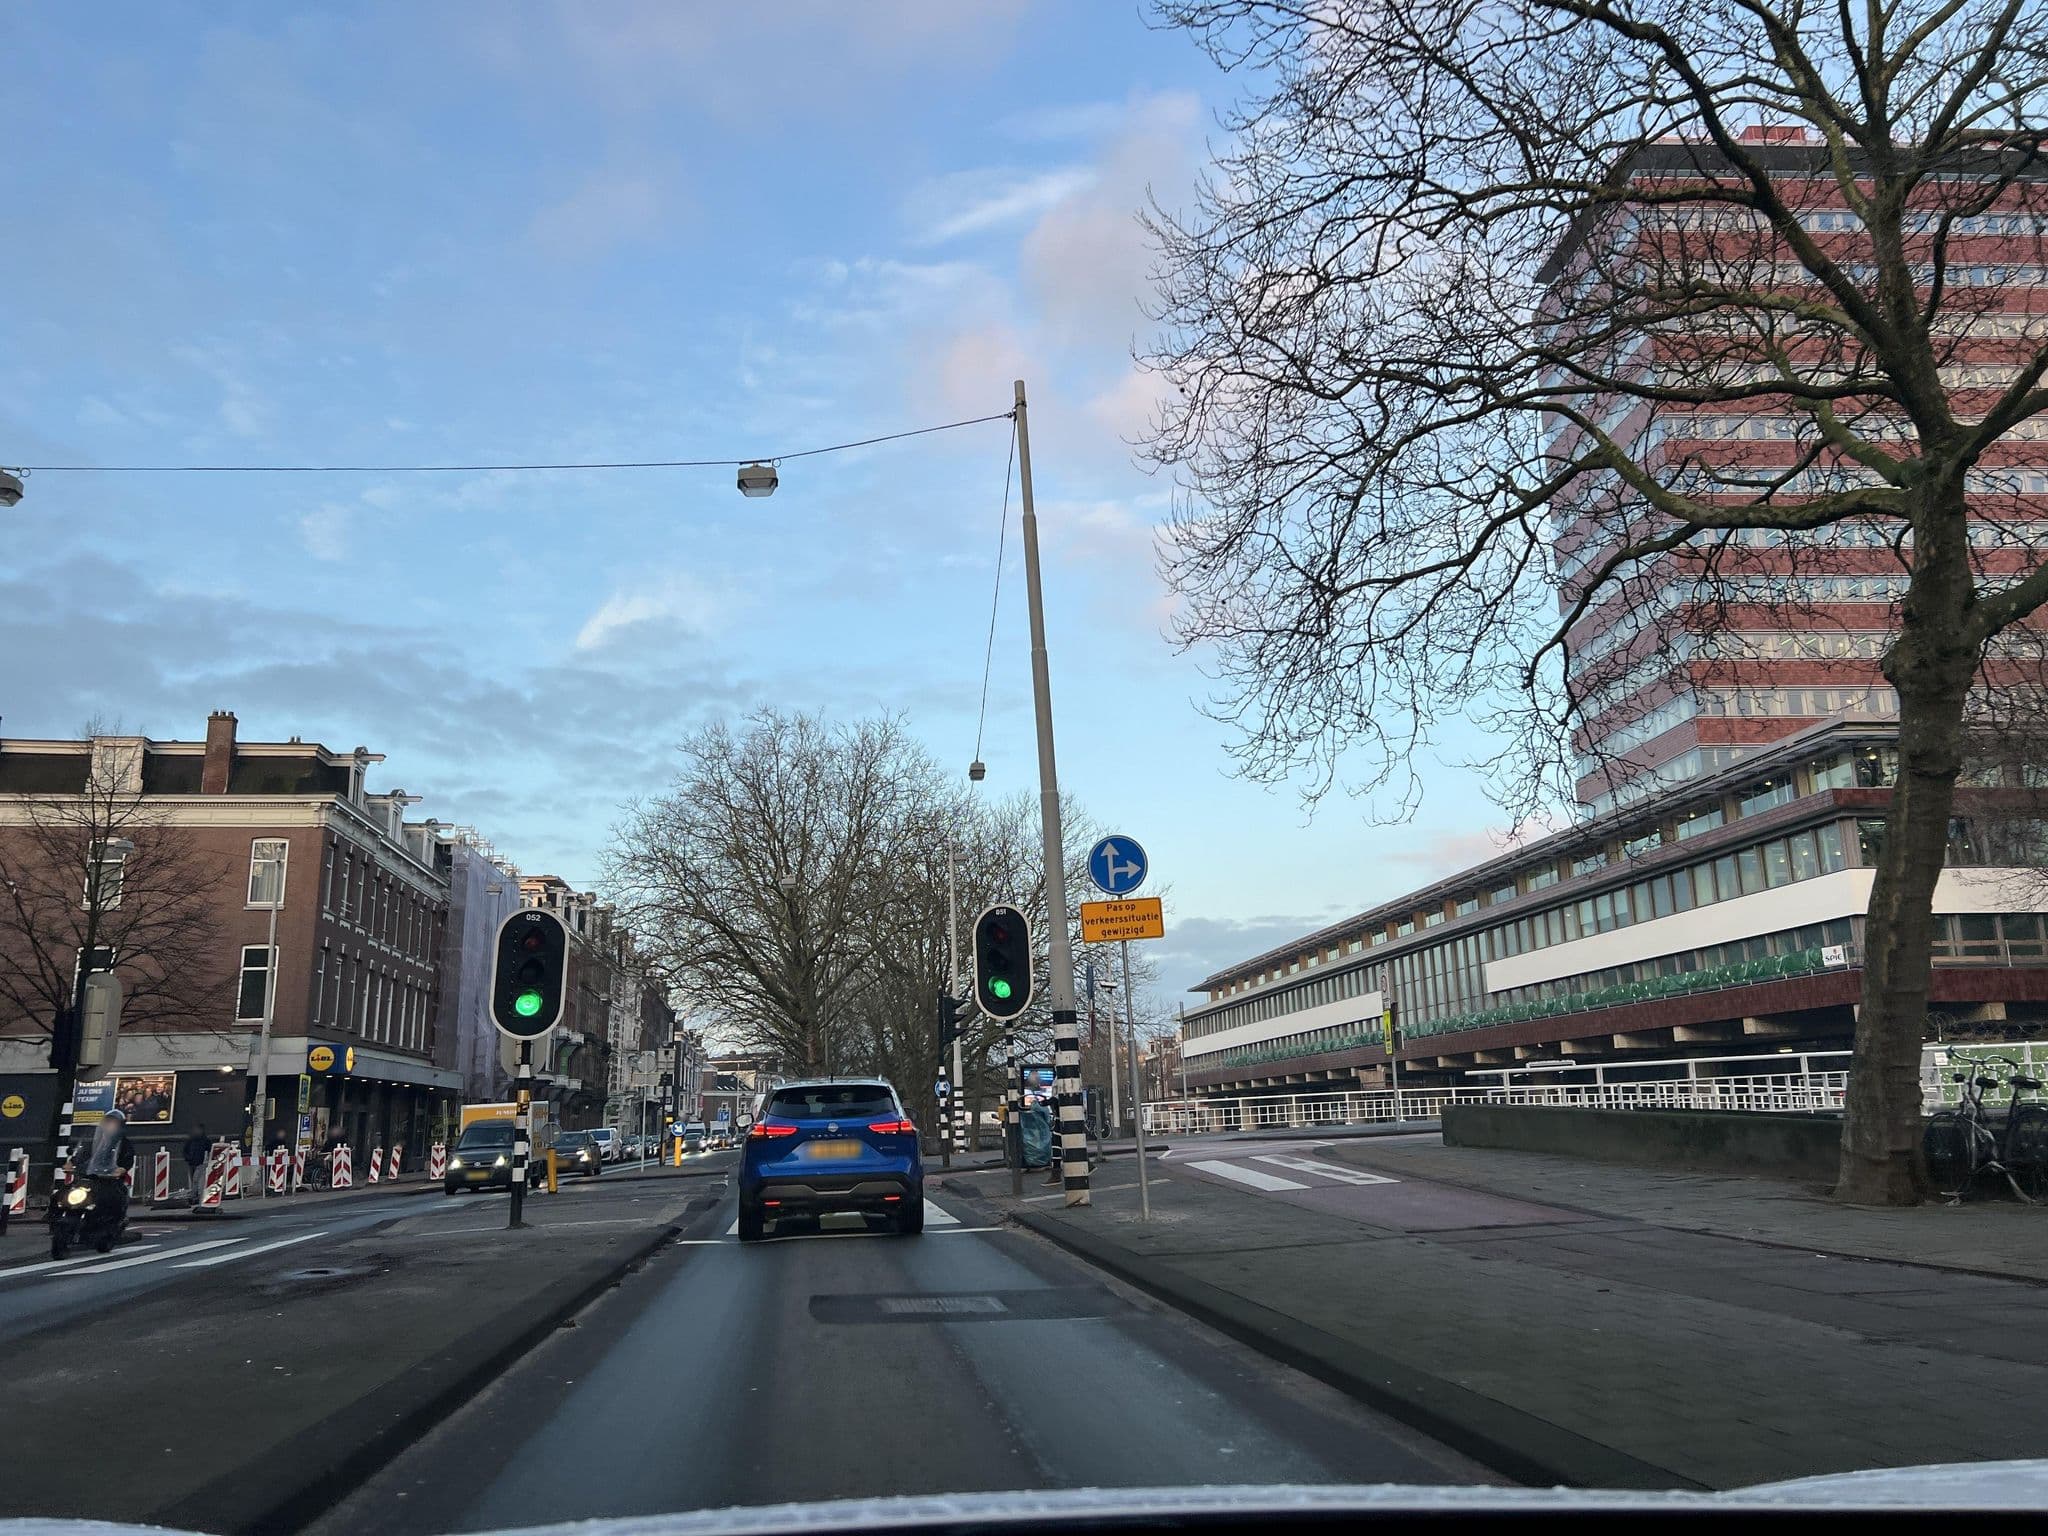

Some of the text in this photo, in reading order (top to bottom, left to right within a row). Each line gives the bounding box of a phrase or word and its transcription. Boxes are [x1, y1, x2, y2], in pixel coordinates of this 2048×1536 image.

[1106, 903, 1136, 912] Pas op
[526, 913, 541, 922] 052
[1085, 912, 1159, 925] verkeerssituatie
[1101, 925, 1145, 938] gewijzigd
